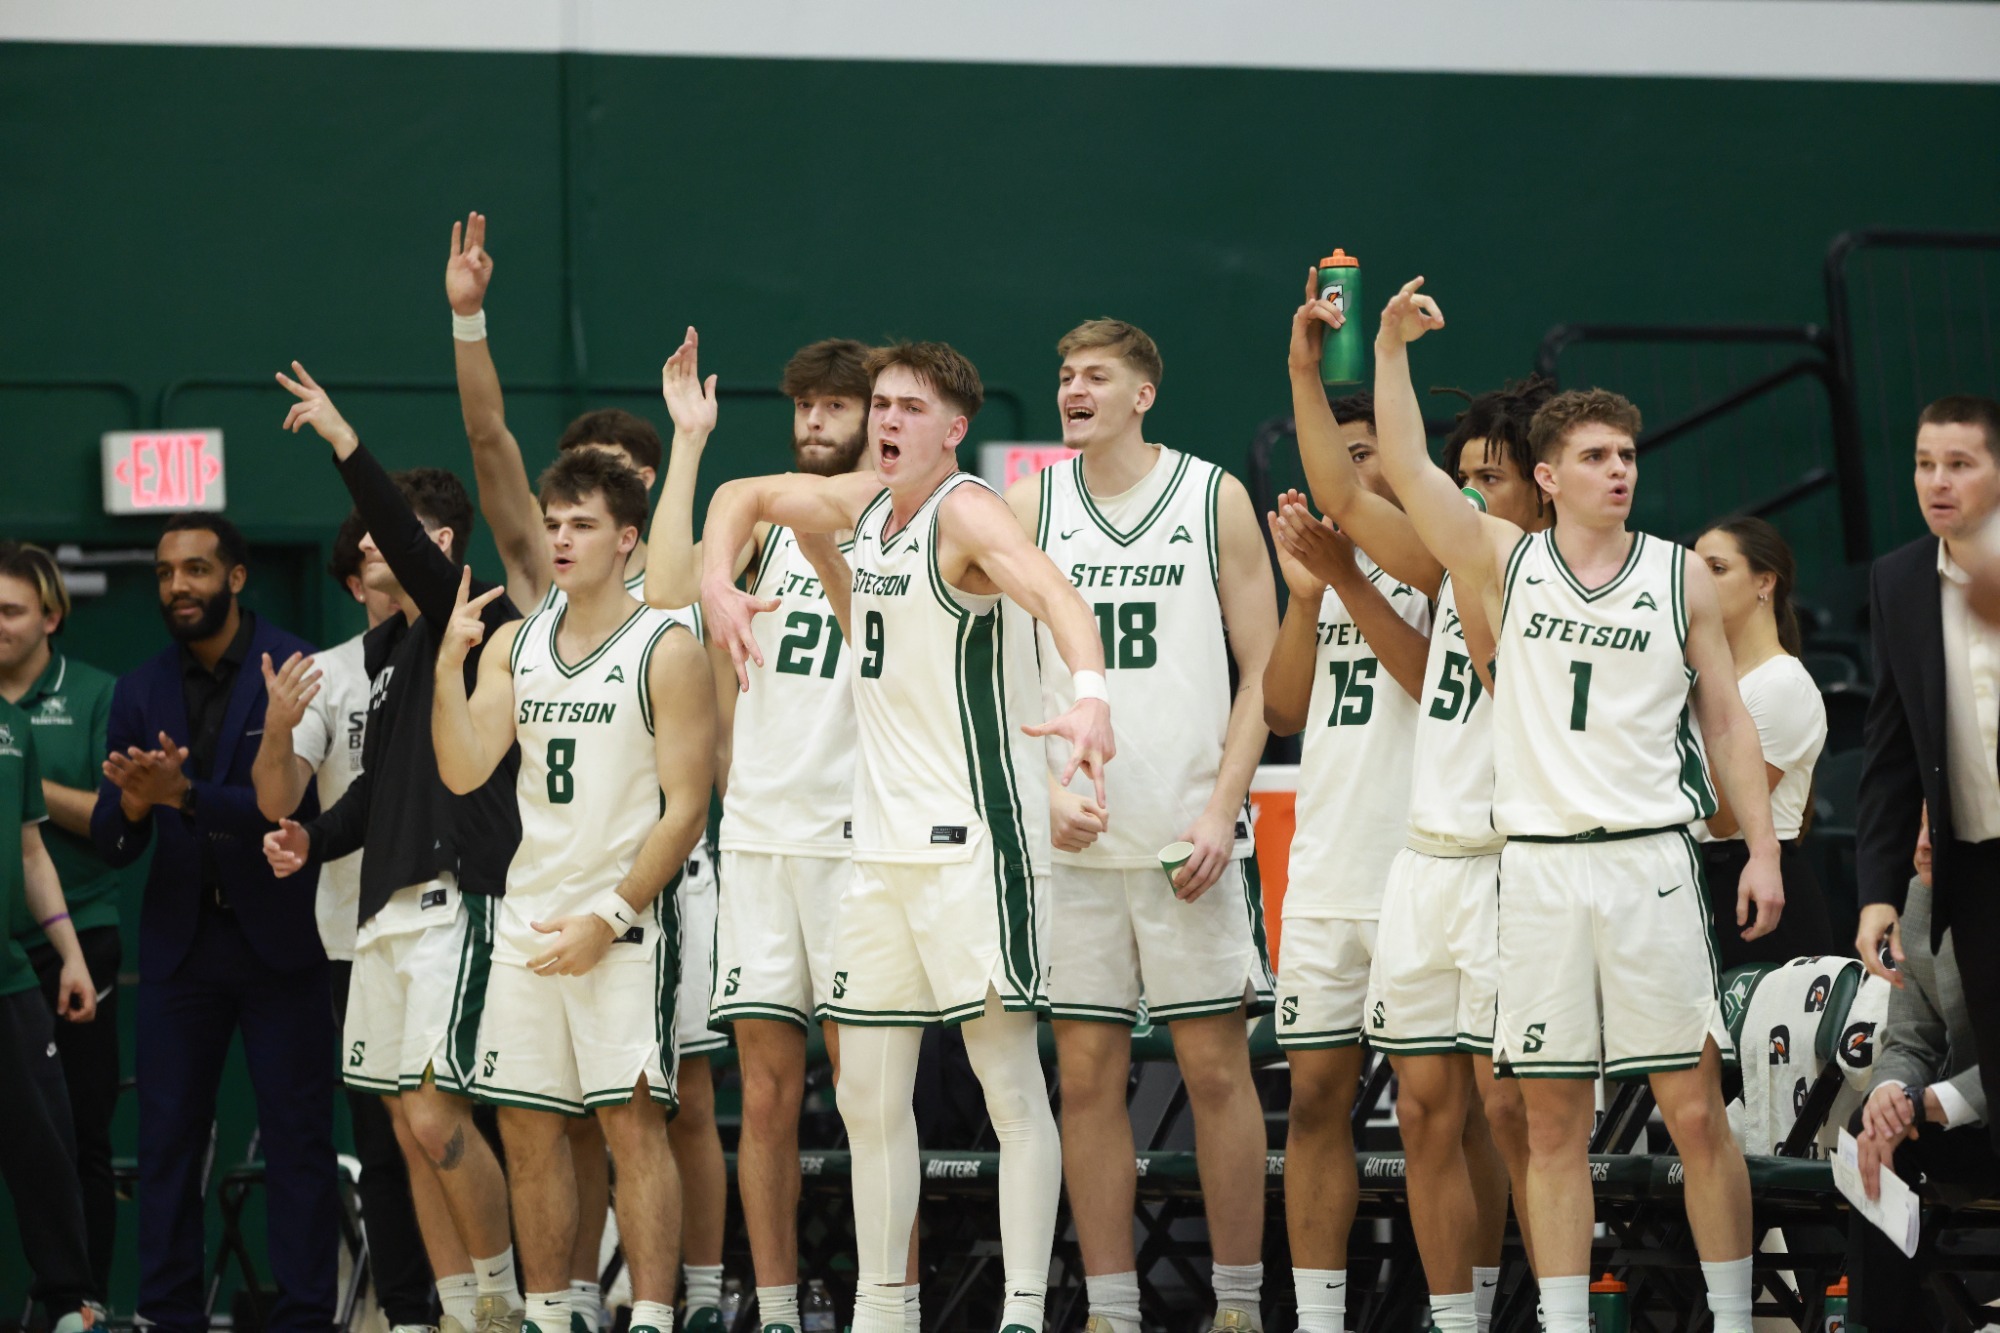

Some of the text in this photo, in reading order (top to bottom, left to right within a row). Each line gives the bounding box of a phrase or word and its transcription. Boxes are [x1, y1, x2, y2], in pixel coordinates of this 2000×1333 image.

[131, 434, 208, 508] EXIT
[1069, 563, 1185, 588] STETSON
[776, 610, 844, 679] 21
[861, 610, 885, 679] 9
[1094, 601, 1157, 669] 18
[1523, 612, 1652, 653] STETSON
[519, 699, 617, 724] STETSON
[1327, 657, 1378, 727] 15
[1569, 660, 1593, 732] 1
[546, 738, 577, 804] 8
[926, 1158, 982, 1178] HATTERS
[1364, 1157, 1406, 1177] HATTER
